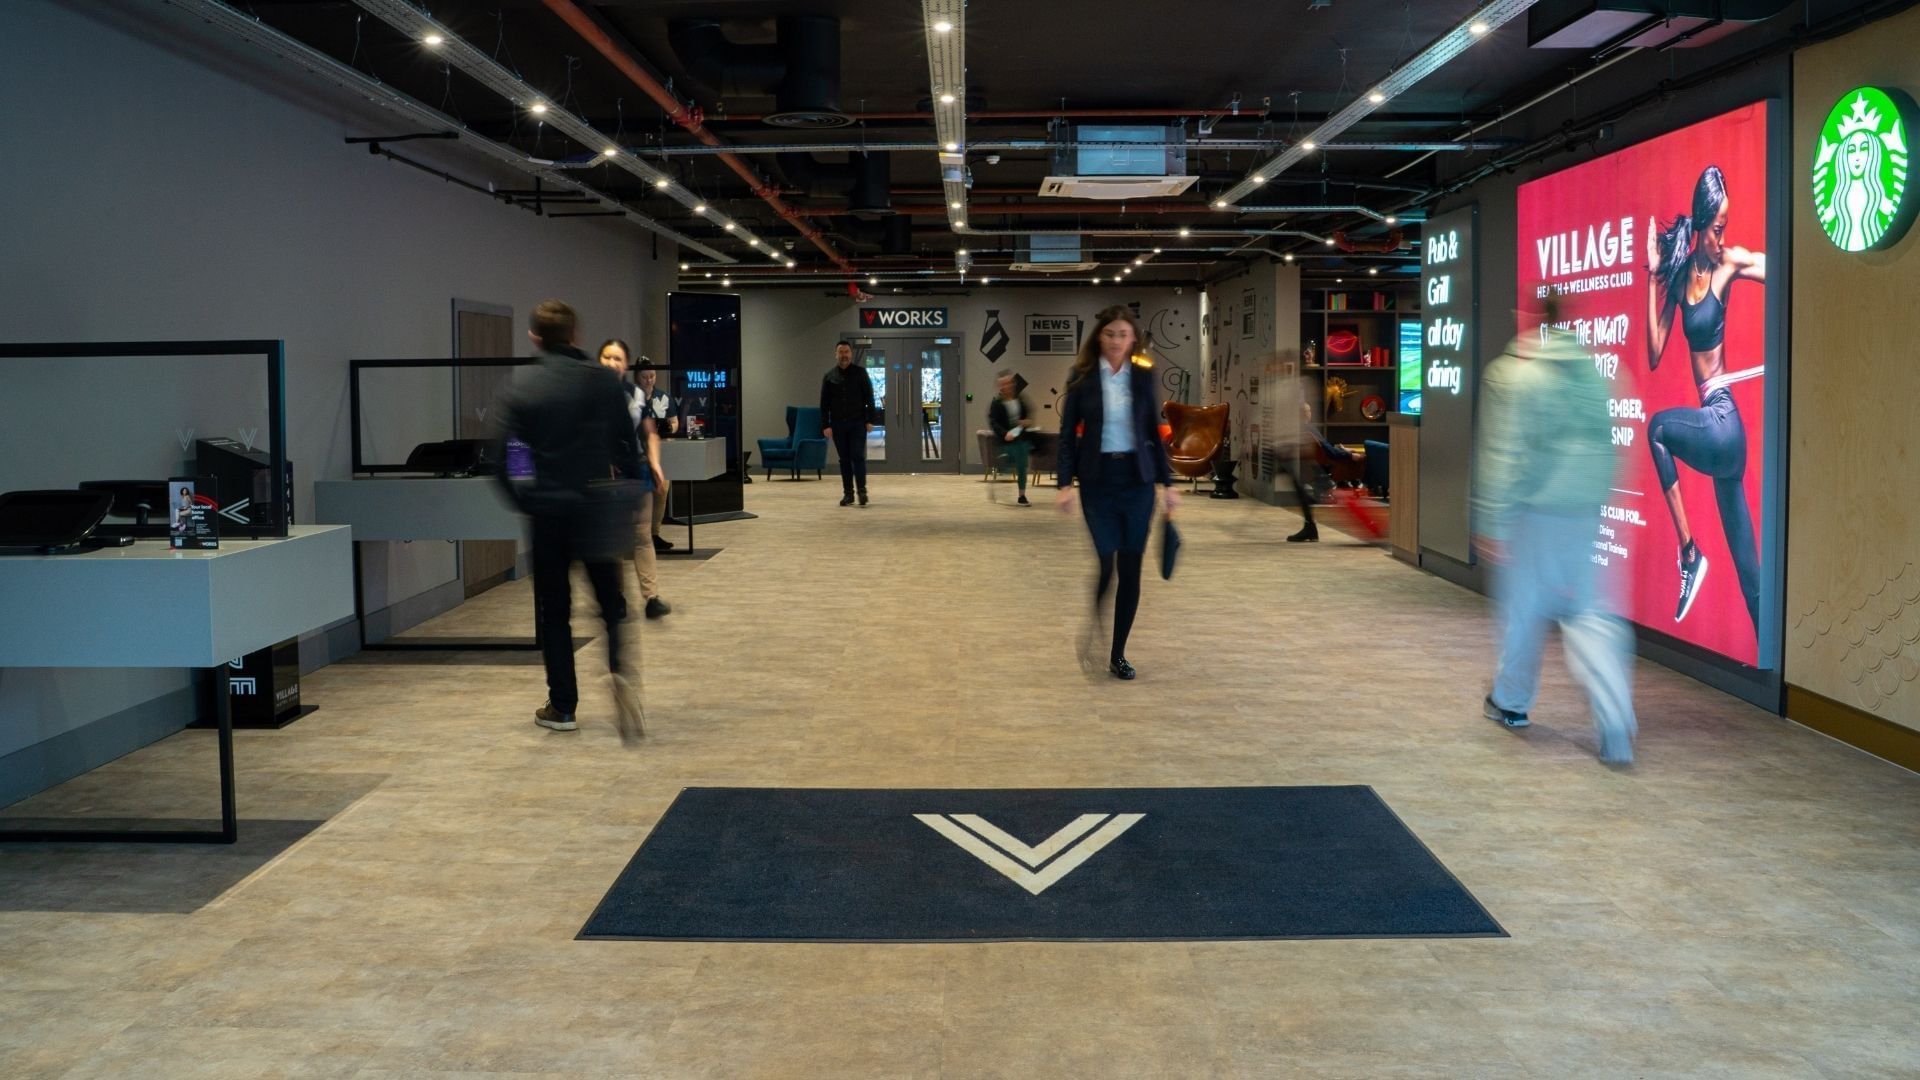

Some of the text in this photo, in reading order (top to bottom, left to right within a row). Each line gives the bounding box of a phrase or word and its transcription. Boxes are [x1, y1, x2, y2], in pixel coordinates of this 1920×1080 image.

[1428, 230, 1458, 265] Pub &
[1537, 217, 1633, 280] VILLAGE
[1428, 275, 1450, 305] Grill
[1610, 271, 1633, 288] CLUB
[879, 310, 943, 326] WORKS
[1032, 319, 1071, 330] NEWS
[1428, 317, 1464, 351] all day
[1573, 318, 1592, 346] THE
[1593, 314, 1629, 347] NIGHT?
[1428, 360, 1461, 395] dining
[1606, 398, 1646, 423] EMBER,
[1611, 426, 1634, 447] SNIP
[1607, 506, 1625, 521] CLUB
[1600, 524, 1615, 539] Dining
[1598, 554, 1609, 566] Pool
[1608, 541, 1628, 558] Training
